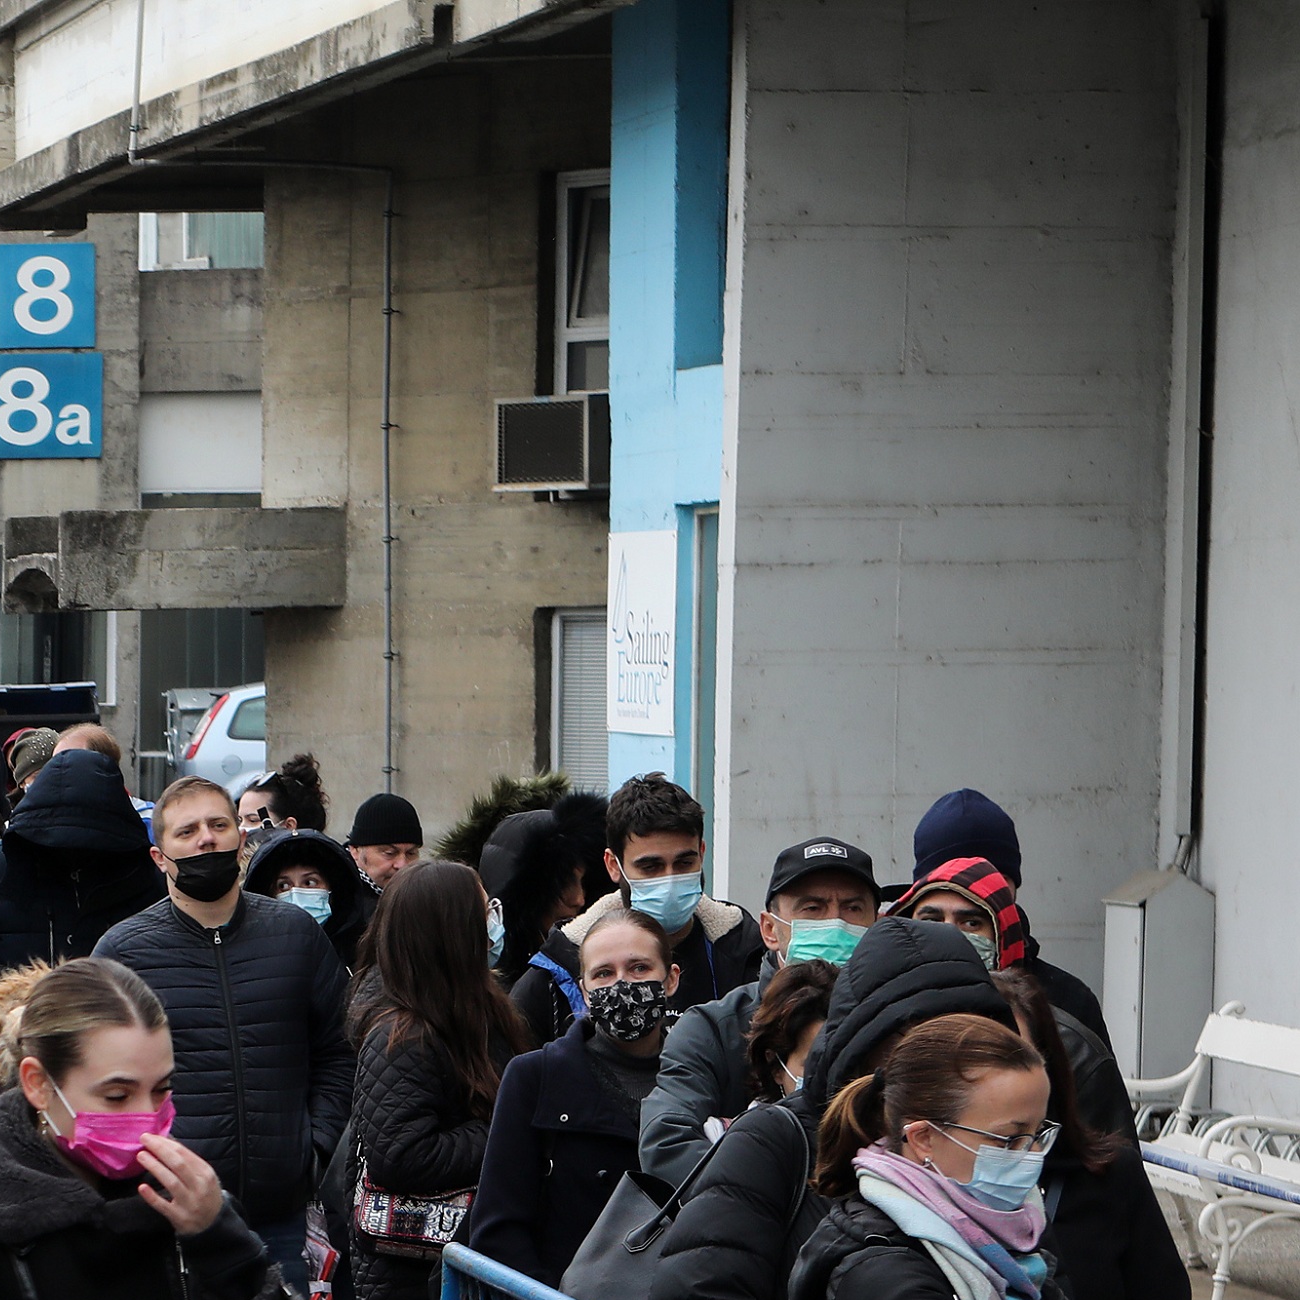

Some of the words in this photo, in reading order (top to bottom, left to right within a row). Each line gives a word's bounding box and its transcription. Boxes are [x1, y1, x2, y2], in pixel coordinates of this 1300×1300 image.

[13, 255, 74, 335] 8
[626, 609, 670, 679] Sailing
[617, 651, 662, 719] Europe
[809, 846, 829, 854] AVL
